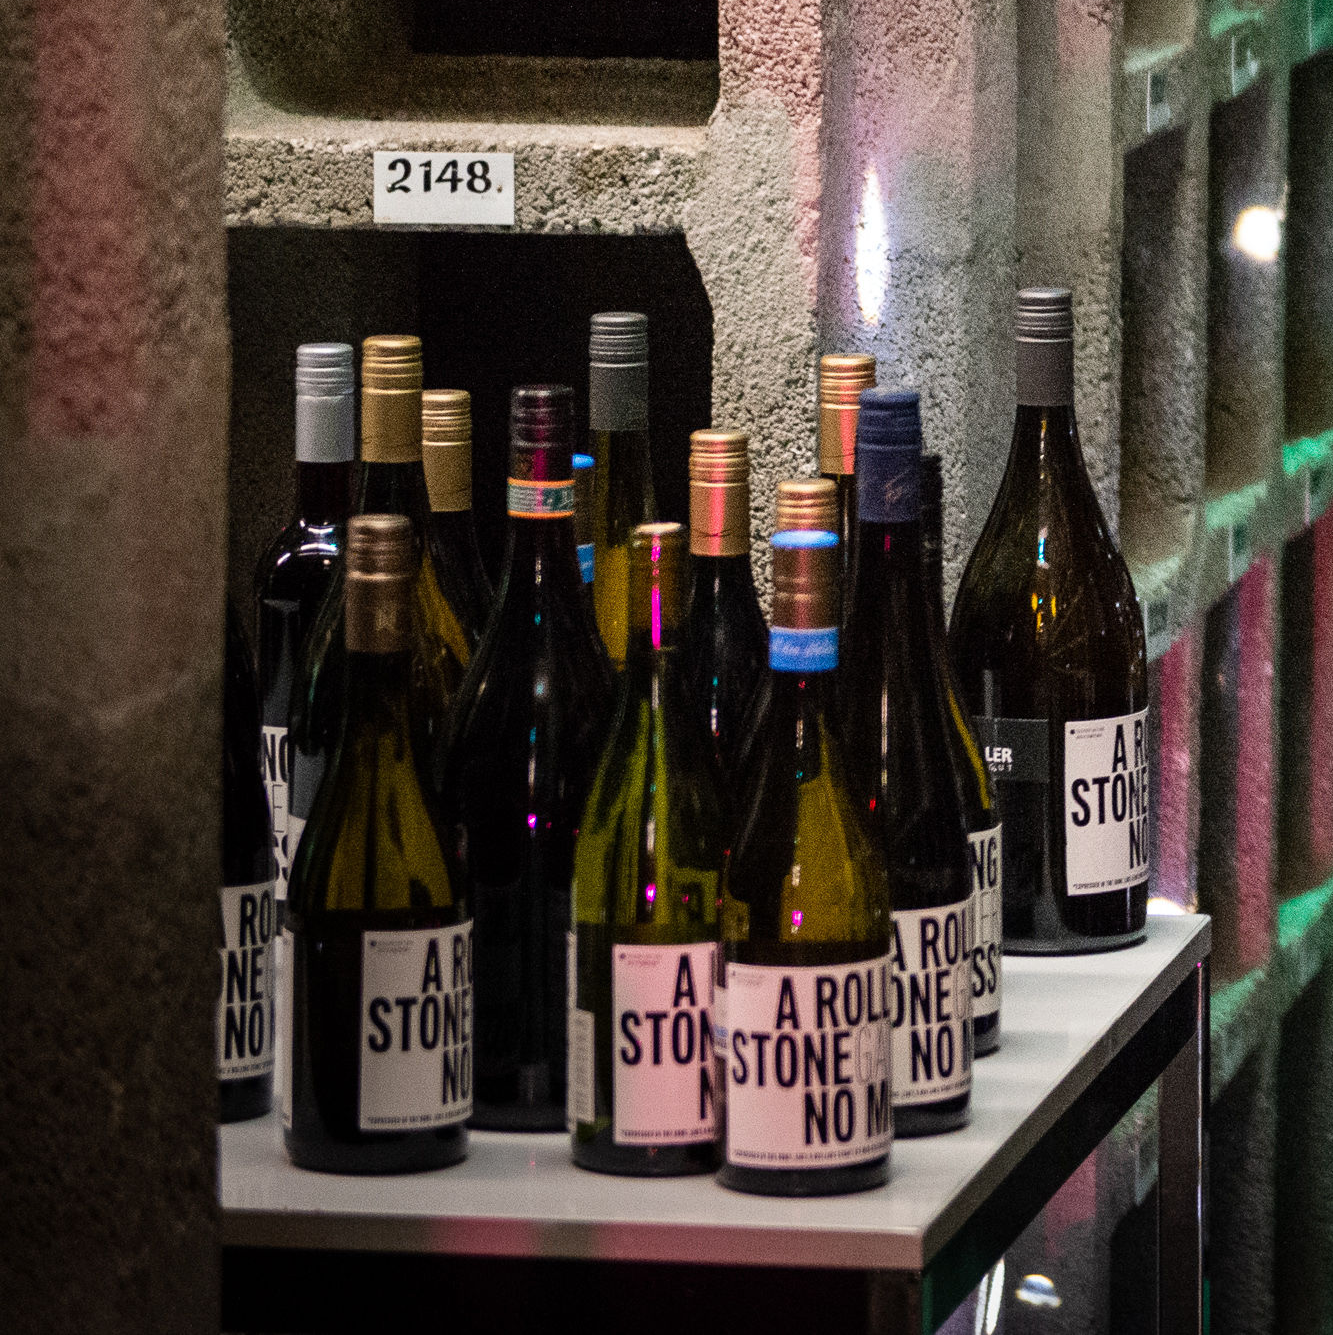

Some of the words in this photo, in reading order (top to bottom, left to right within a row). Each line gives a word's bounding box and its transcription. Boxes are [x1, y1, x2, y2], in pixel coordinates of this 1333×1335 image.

[386, 158, 493, 194] 2148
[985, 746, 1013, 763] LER
[1112, 723, 1128, 773] A
[1071, 767, 1148, 827] STONE
[421, 938, 443, 993] A
[673, 953, 696, 1007] A
[368, 987, 471, 1053] STONE
[775, 975, 799, 1029] A
[224, 1002, 264, 1060] NO
[732, 1031, 852, 1087] STONE
[911, 1026, 953, 1082] NO
[442, 1046, 471, 1105] NO
[804, 1088, 854, 1145] NO
